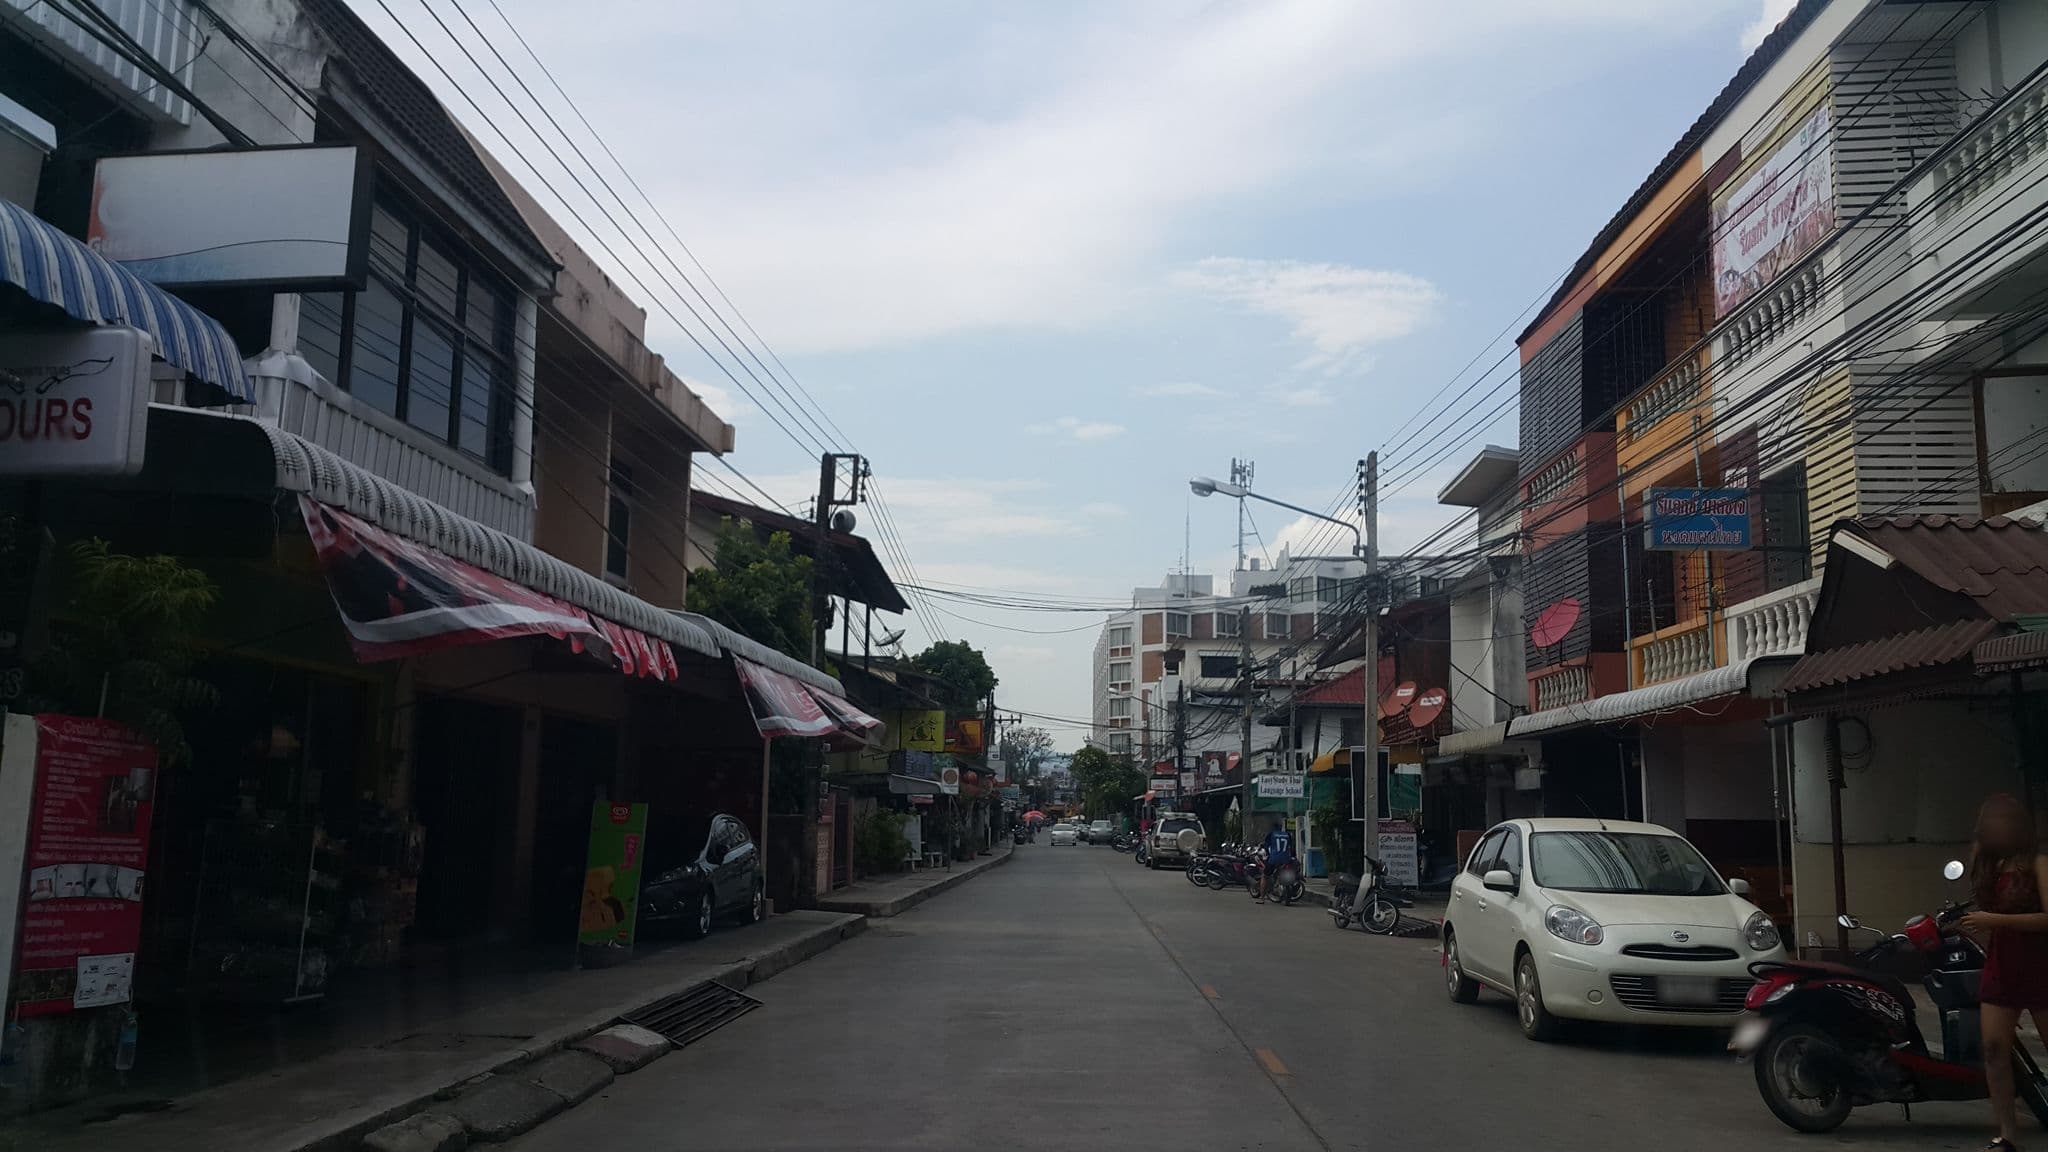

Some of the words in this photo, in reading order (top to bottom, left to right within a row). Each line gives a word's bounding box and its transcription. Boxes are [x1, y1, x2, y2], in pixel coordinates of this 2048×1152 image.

[1661, 516, 1743, 545] นวดแผนไทย
[1260, 784, 1284, 794] Language
[1285, 786, 1302, 794] School
[1276, 838, 1288, 852] 17
